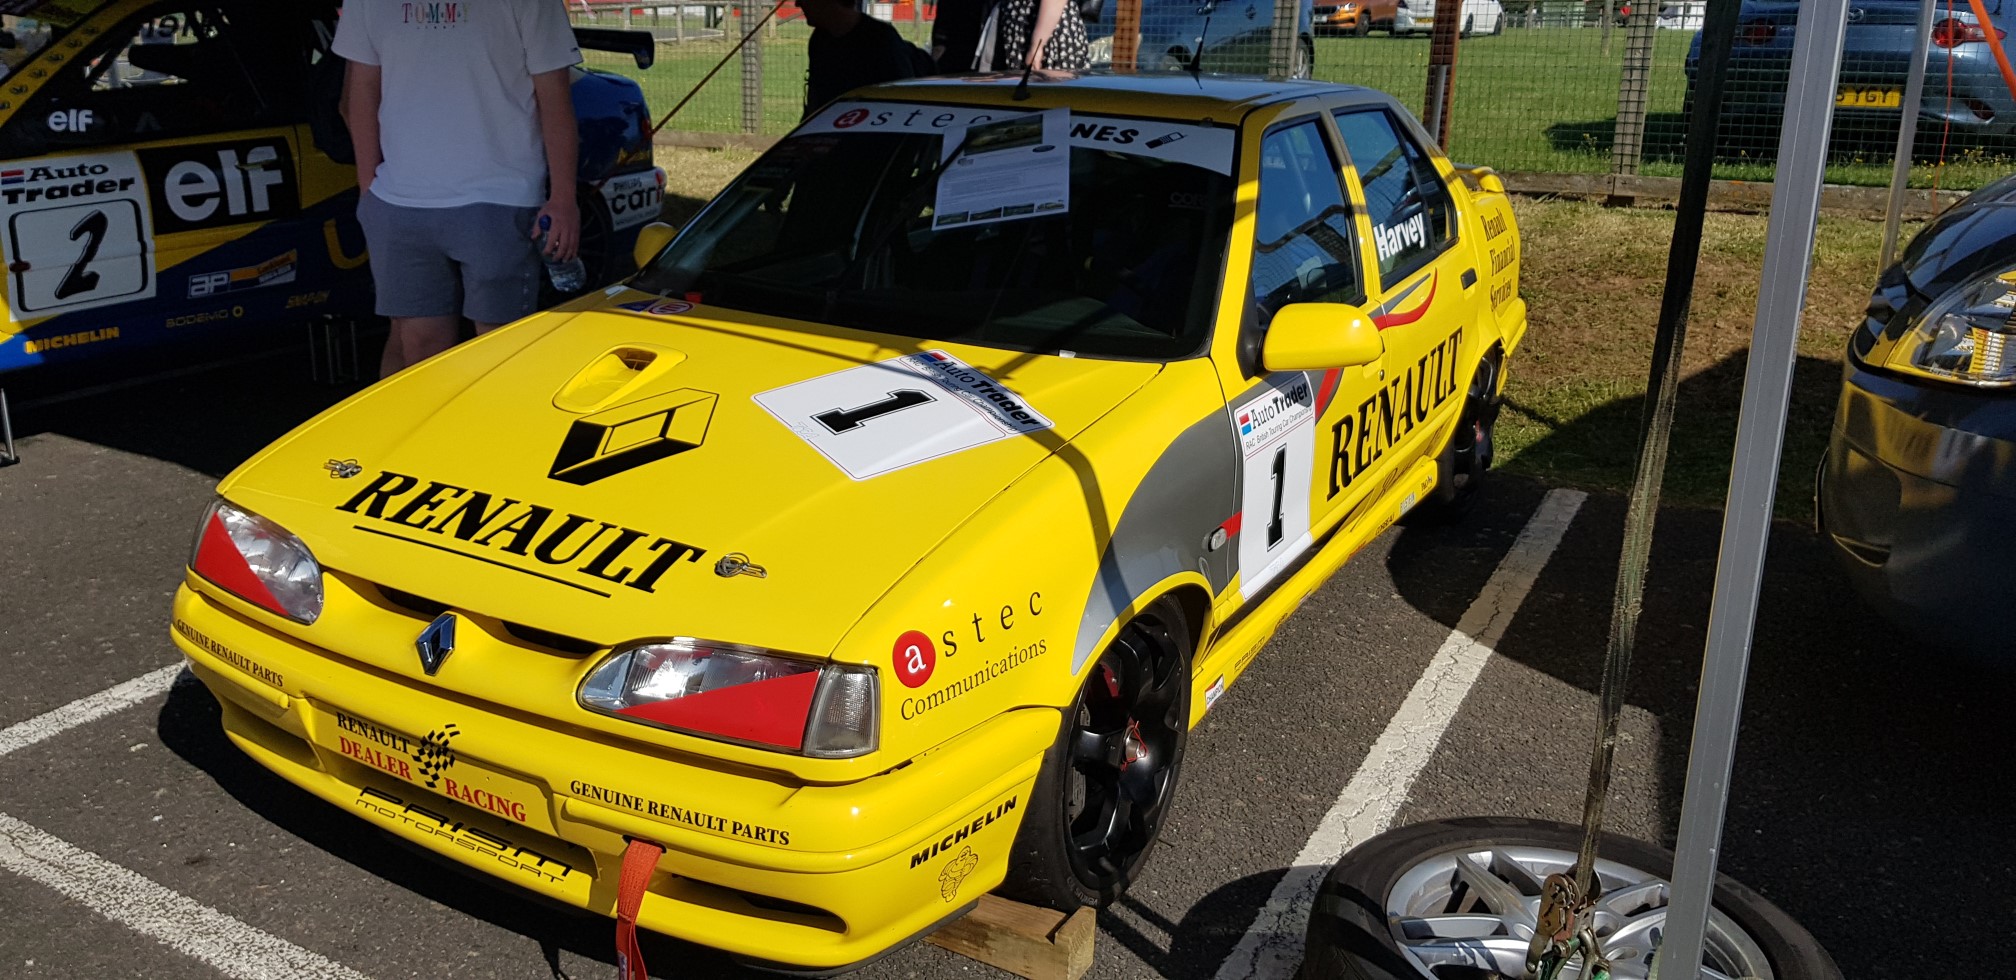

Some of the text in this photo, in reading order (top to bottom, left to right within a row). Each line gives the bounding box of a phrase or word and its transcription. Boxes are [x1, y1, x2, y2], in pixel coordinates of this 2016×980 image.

[402, 3, 470, 23] TOMMY
[48, 108, 93, 132] elf
[1070, 123, 1139, 144] NES
[2, 176, 135, 205] Trader
[26, 163, 109, 183] Auto
[164, 146, 283, 222] elf
[1373, 212, 1426, 261] Harvey
[1481, 208, 1507, 242] Renault
[55, 209, 108, 300] 2
[1490, 236, 1515, 277] Financial
[1490, 278, 1512, 312] Services
[24, 327, 120, 354] MICHELIN
[811, 388, 938, 435] 1
[1326, 325, 1463, 502] RENAULT
[1266, 442, 1287, 553] 1
[335, 470, 707, 594] RENAULT
[178, 619, 284, 687] GENUINE RENAULT PARTS
[904, 591, 1042, 674] astec
[901, 639, 1047, 721] Communications
[337, 712, 410, 754] RENAULT
[339, 736, 412, 780] DEALER
[444, 777, 527, 822] RACING
[570, 780, 790, 845] GENUINE RENAULT PARTS
[356, 799, 564, 882] MOTORSPORT
[360, 786, 573, 876] PRISM
[910, 794, 1018, 869] MICHELIN
